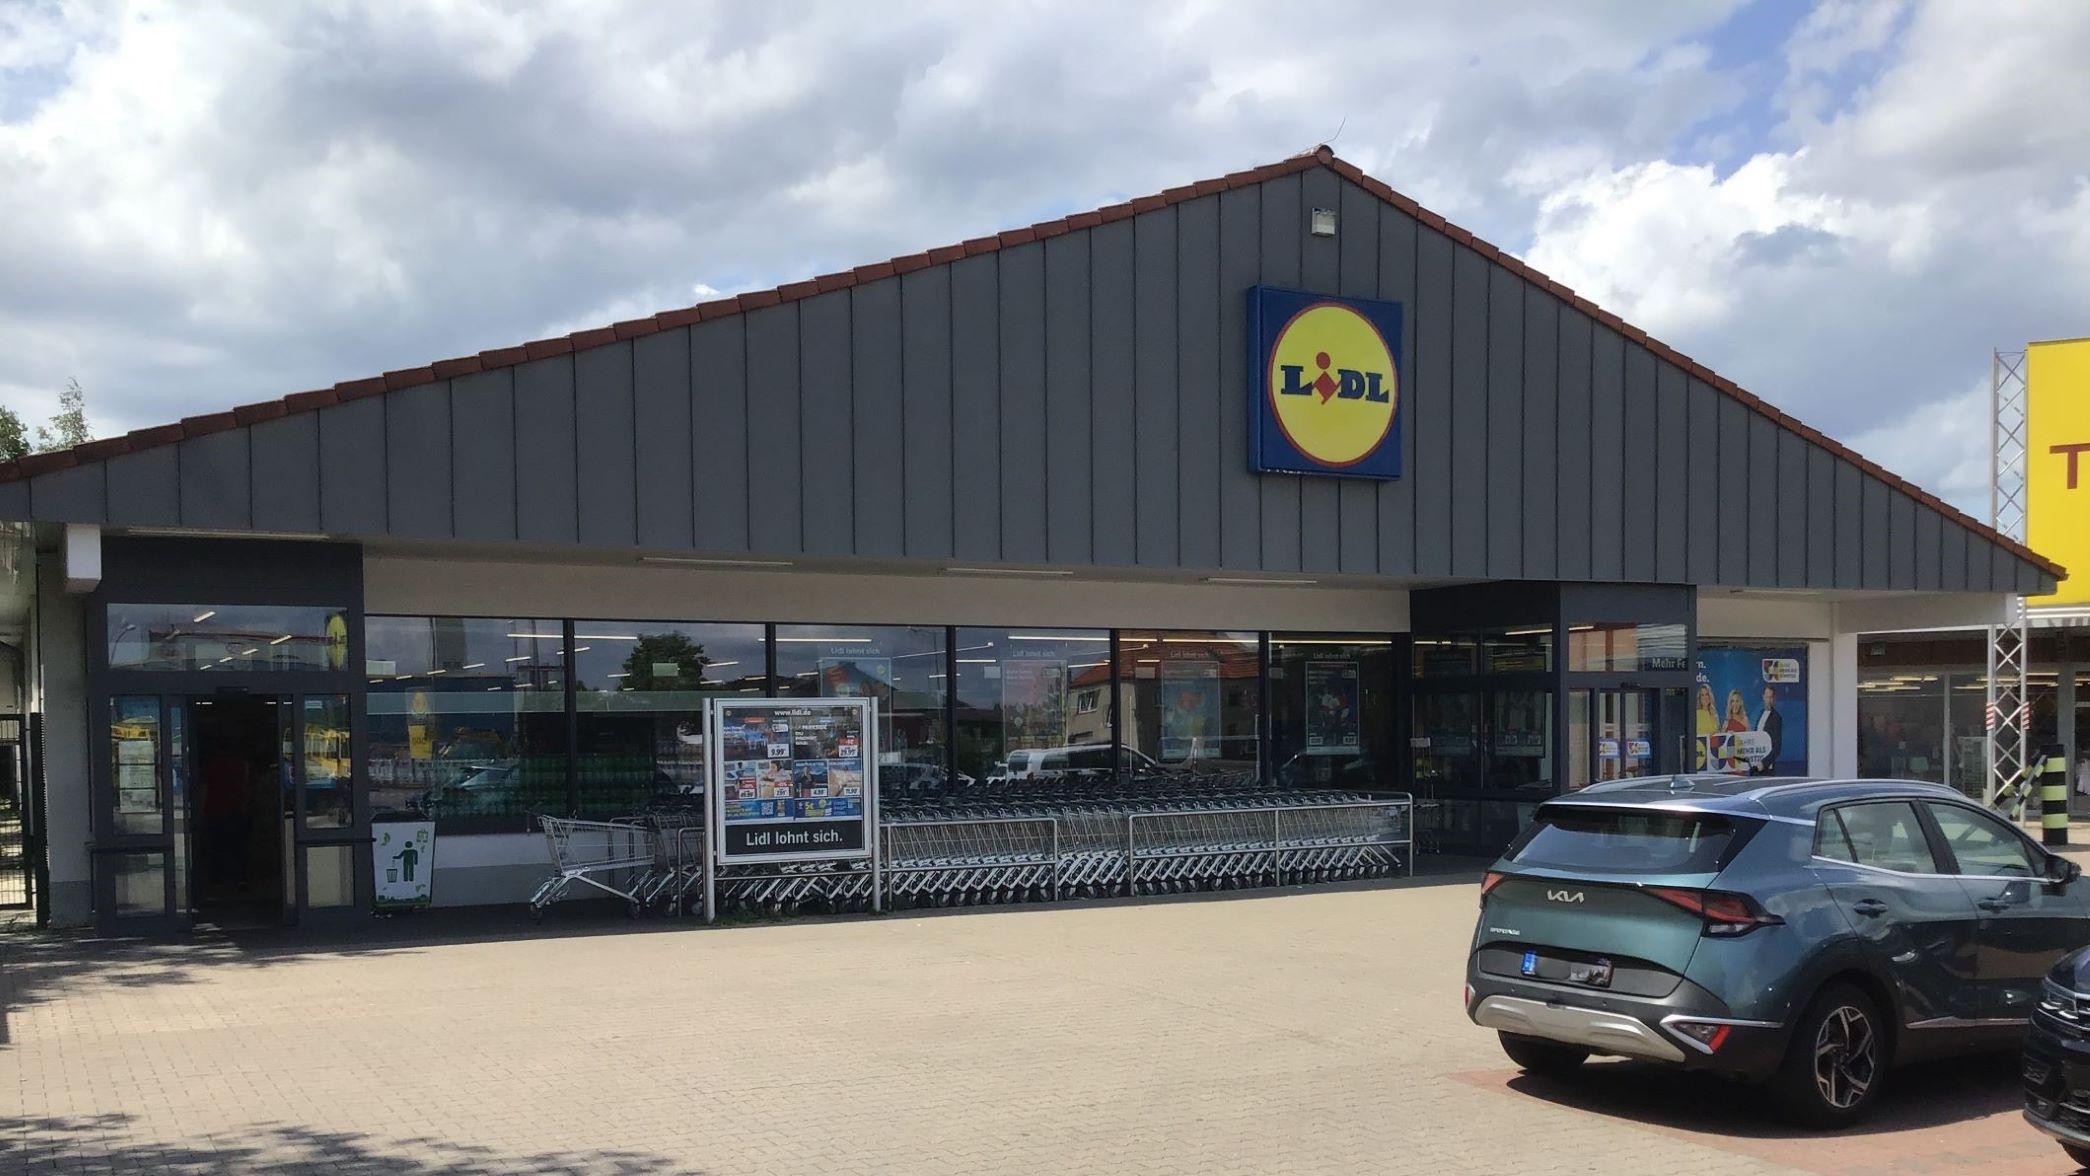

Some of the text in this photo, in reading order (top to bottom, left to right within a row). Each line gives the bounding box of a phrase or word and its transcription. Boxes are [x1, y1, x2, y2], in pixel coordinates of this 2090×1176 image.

[1280, 352, 1390, 405] LIDL
[745, 829, 843, 846] Lidl lohnt sich.
[1547, 889, 1584, 903] KIA
